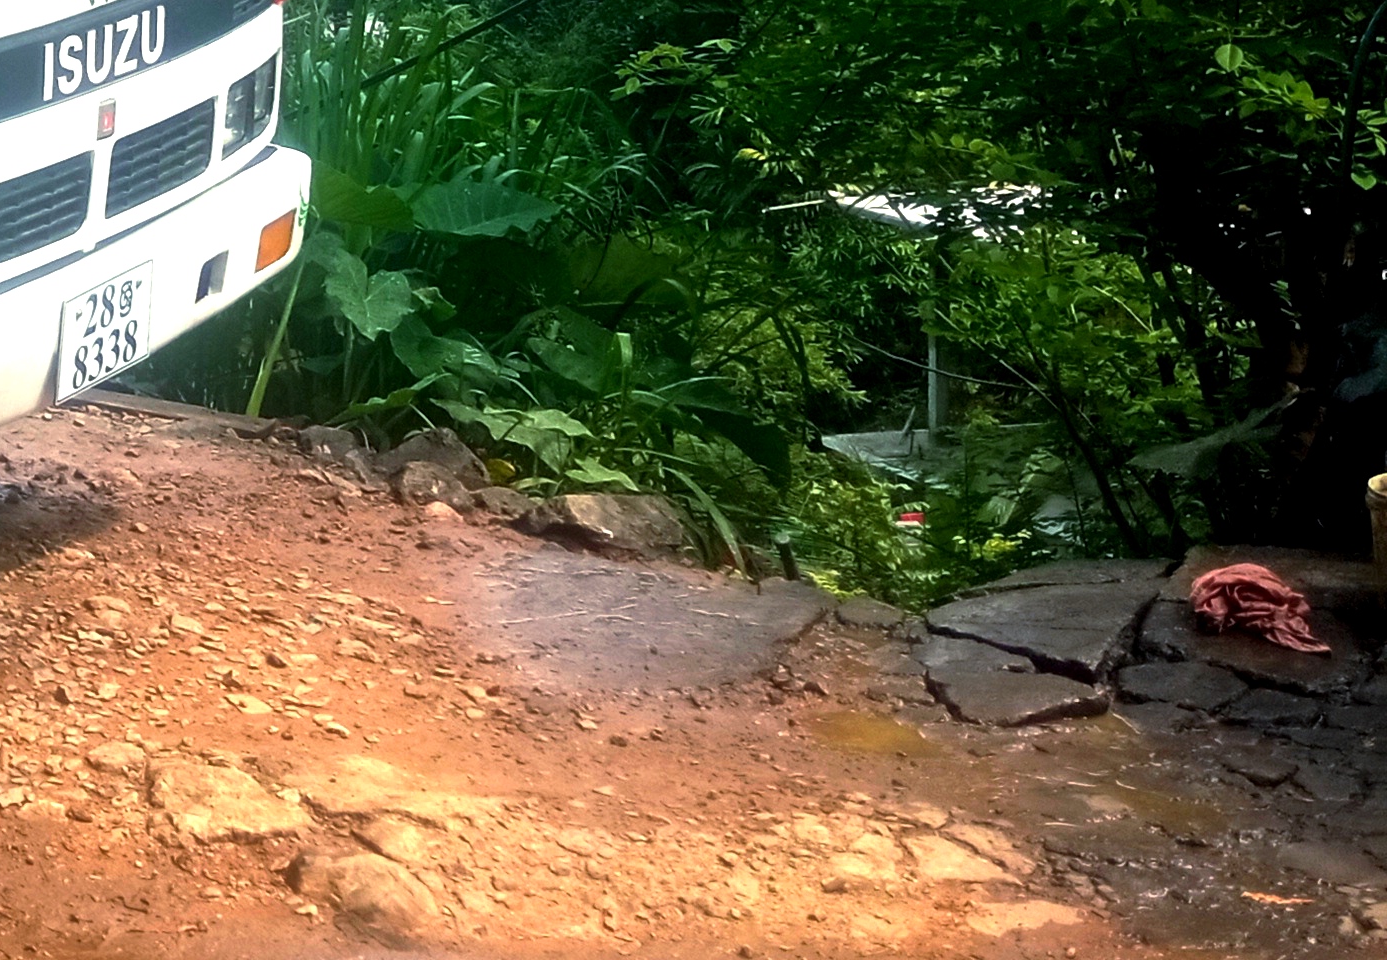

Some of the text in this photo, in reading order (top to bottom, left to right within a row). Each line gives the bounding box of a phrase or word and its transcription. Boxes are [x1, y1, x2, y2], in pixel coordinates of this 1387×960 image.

[42, 5, 166, 102] ISUZU
[83, 284, 116, 339] 28
[72, 319, 138, 390] 8338
